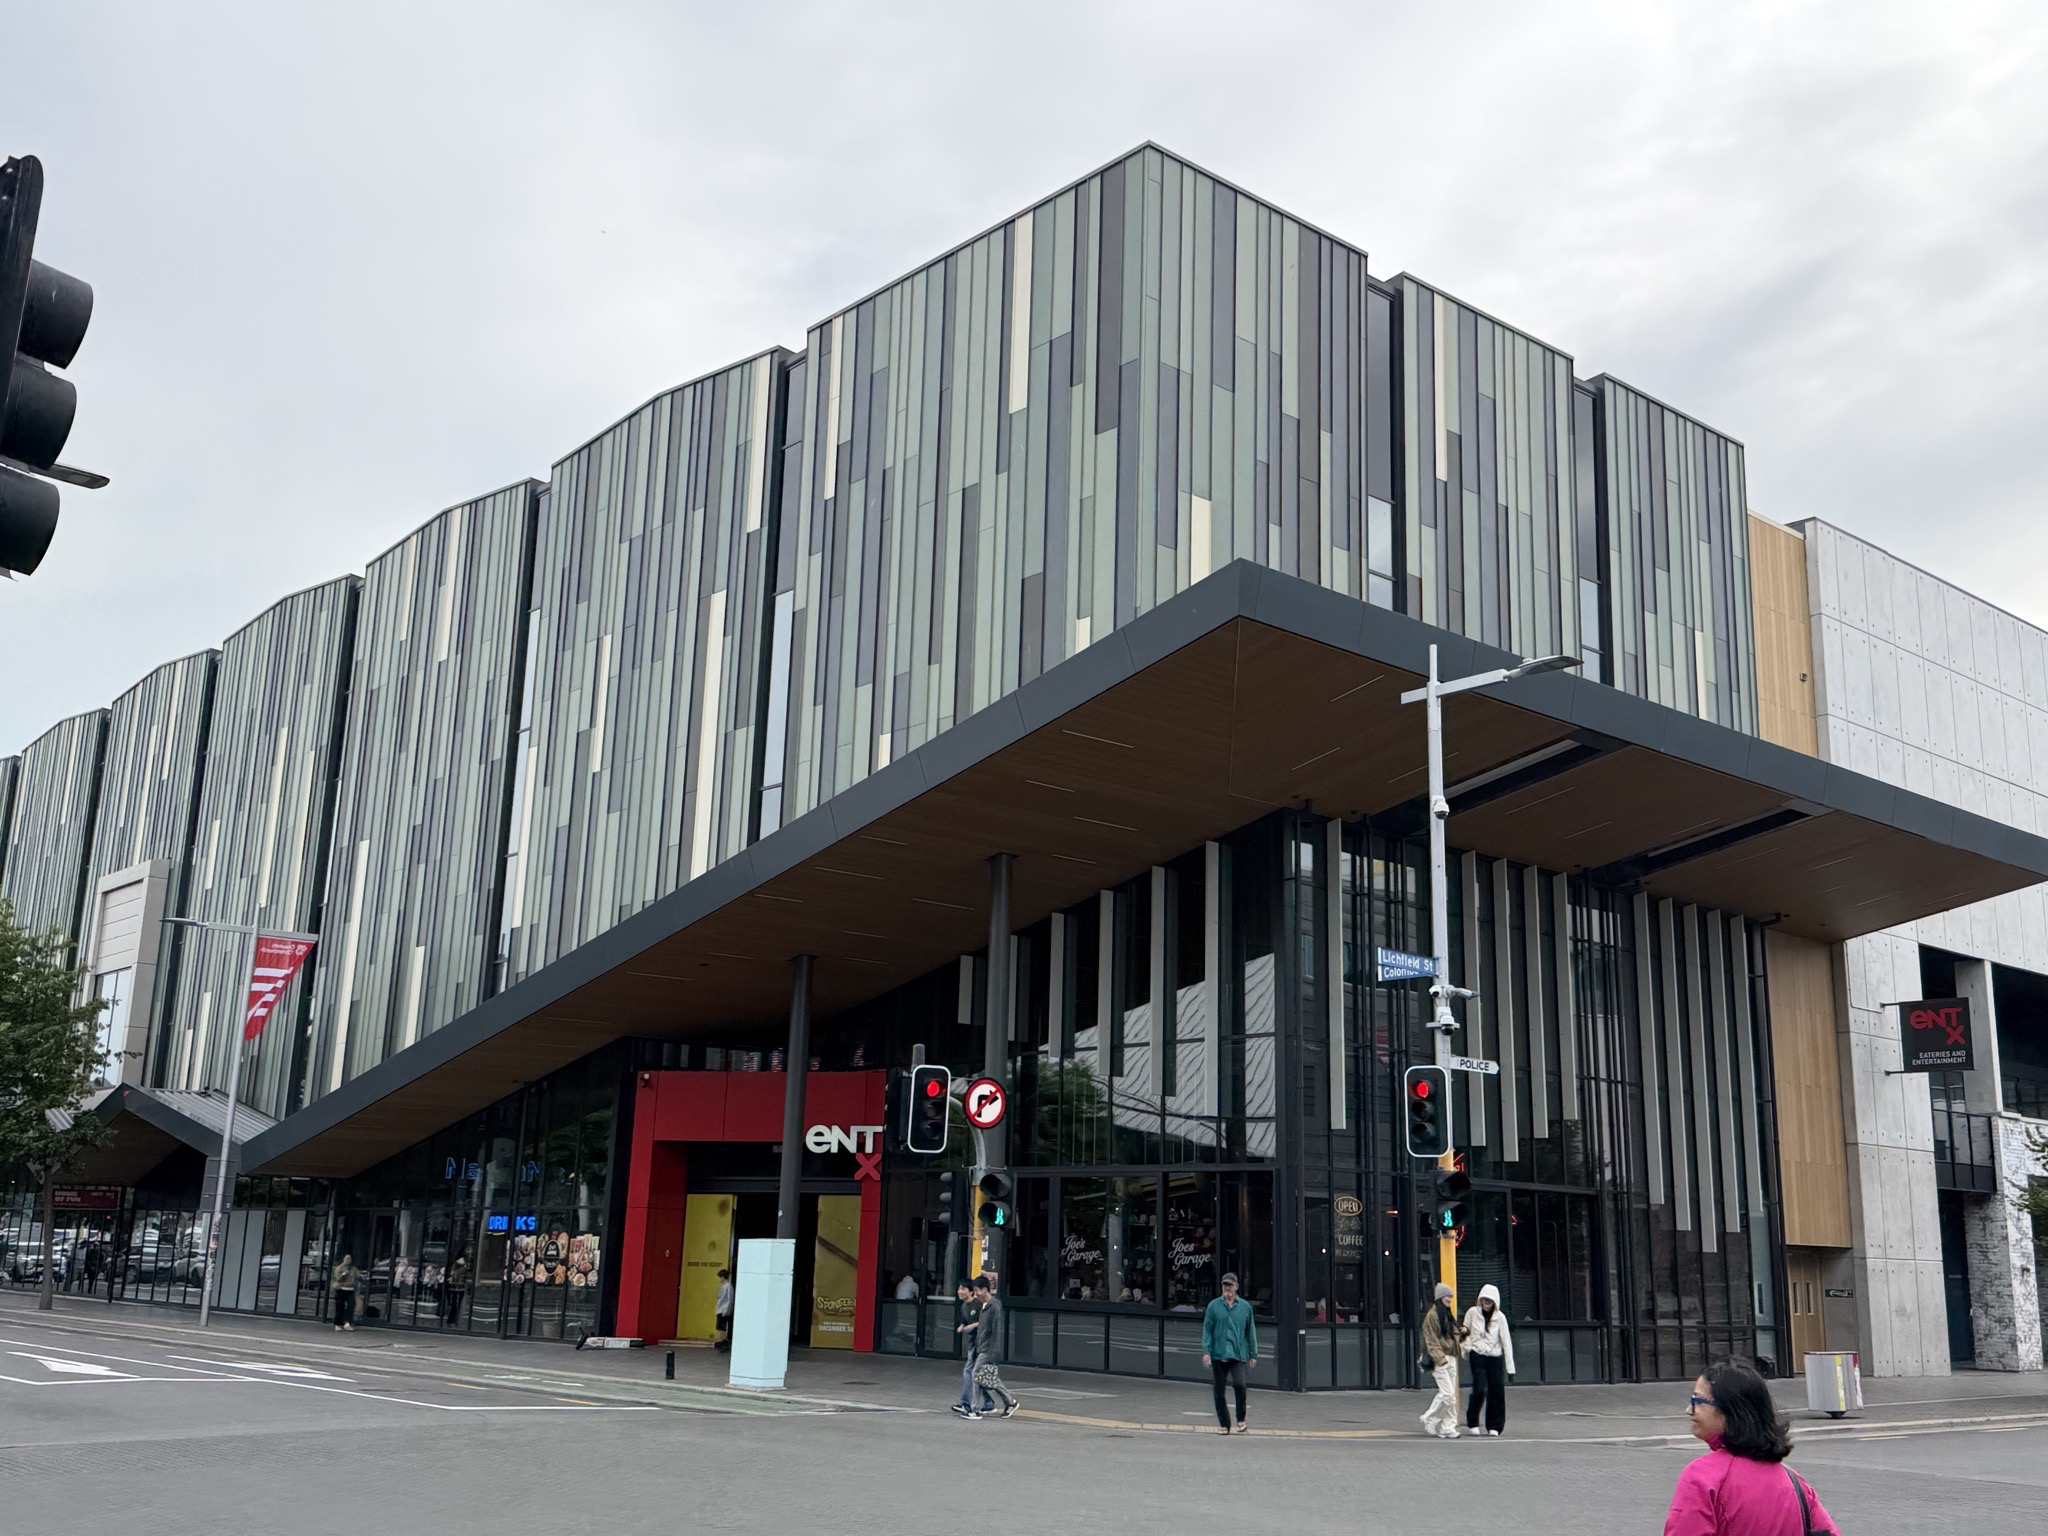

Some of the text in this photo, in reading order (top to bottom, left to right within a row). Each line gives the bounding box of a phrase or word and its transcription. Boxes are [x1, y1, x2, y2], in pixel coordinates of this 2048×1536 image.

[1382, 949, 1434, 972] Lichfield St
[1912, 1056, 1967, 1066] ENTERTAINMENT
[1920, 1051, 1951, 1059] EATERIES
[1460, 1059, 1489, 1071] POLICE
[1338, 1200, 1359, 1212] OPEN
[488, 1215, 536, 1231] DRIKS
[1338, 1234, 1364, 1246] COFFEE
[1065, 1249, 1101, 1267] Garage
[1172, 1252, 1211, 1271] Garage
